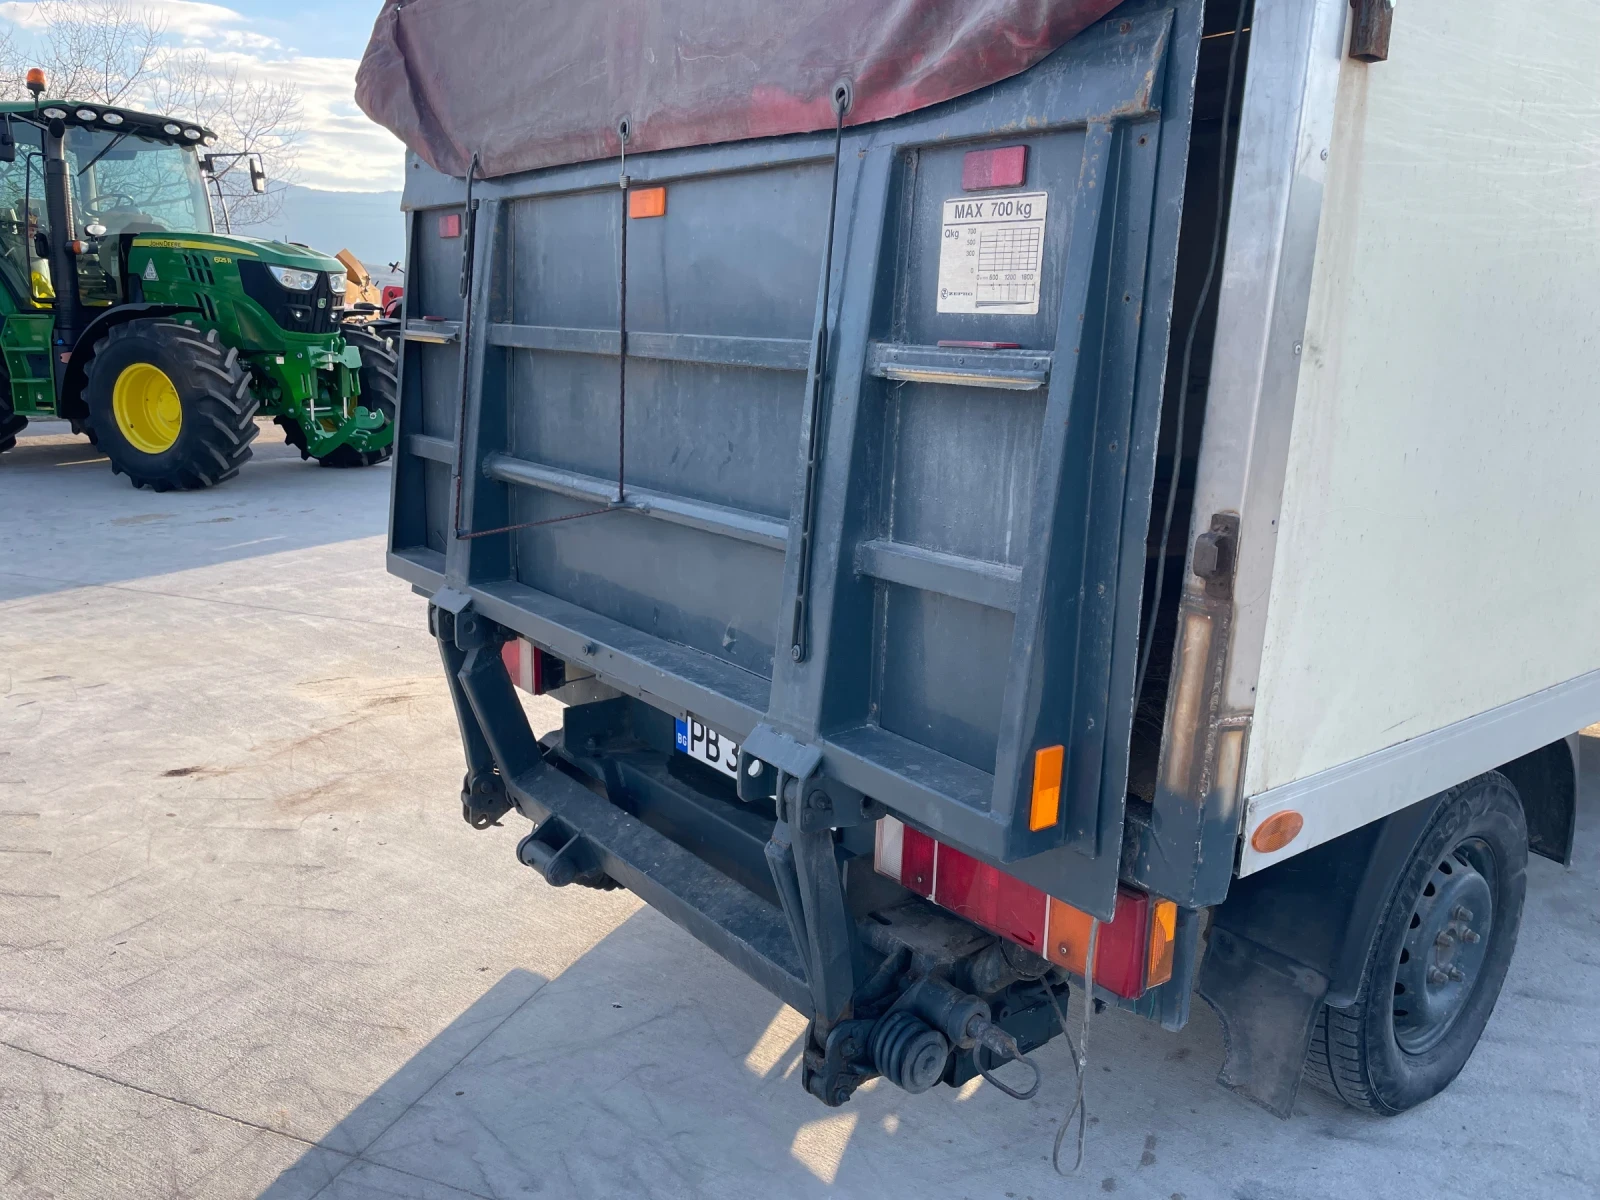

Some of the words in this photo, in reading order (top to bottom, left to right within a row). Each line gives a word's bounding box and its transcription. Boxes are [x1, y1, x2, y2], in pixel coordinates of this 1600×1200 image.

[954, 203, 983, 219] MAX
[991, 201, 1013, 217] 700
[1016, 201, 1032, 218] kg
[944, 229, 959, 239] Qkg
[163, 240, 181, 248] DEERE
[966, 238, 976, 246] 500
[677, 732, 687, 746] BG
[691, 719, 720, 763] PB
